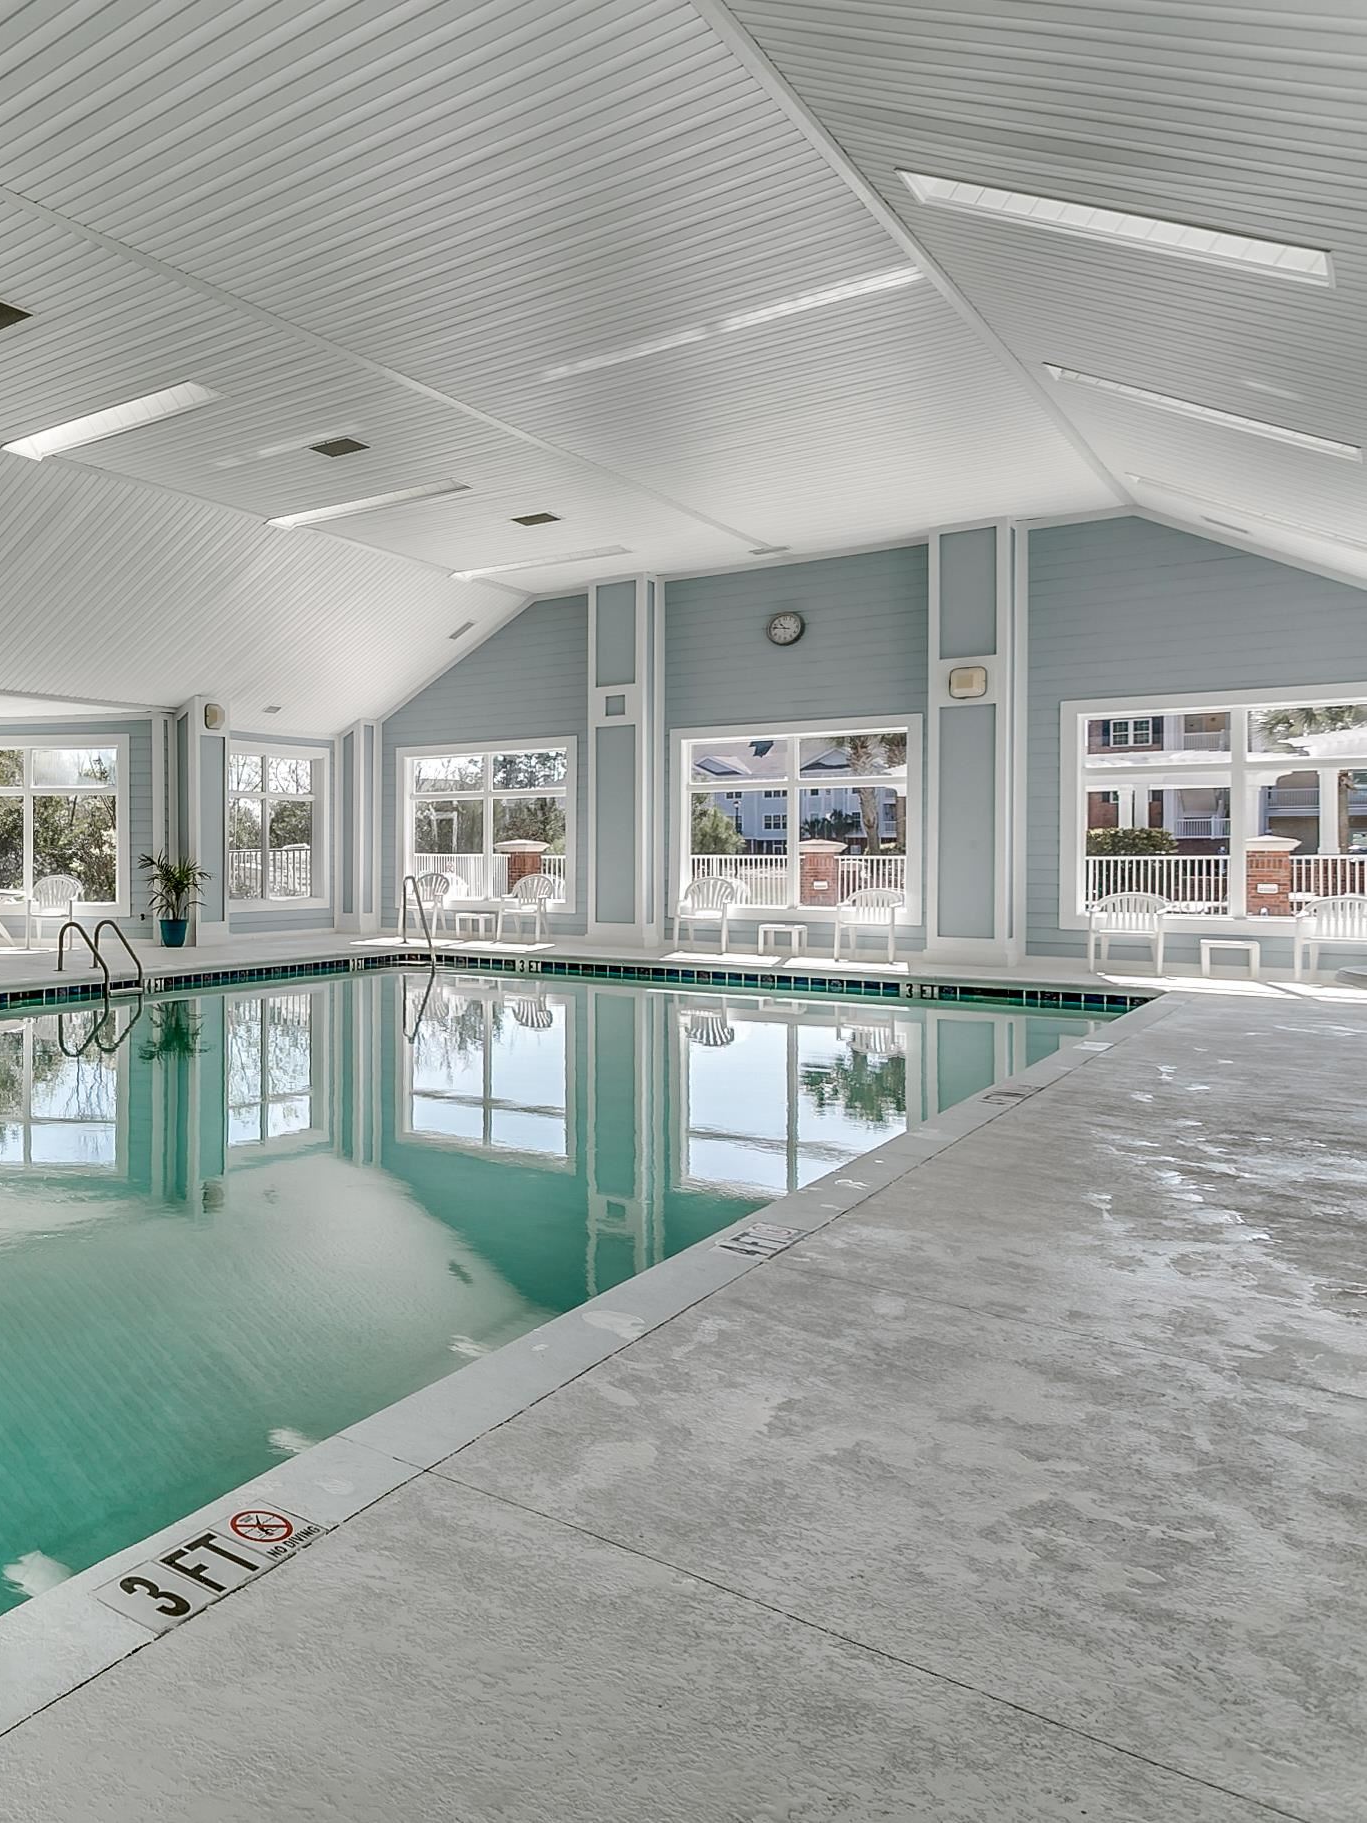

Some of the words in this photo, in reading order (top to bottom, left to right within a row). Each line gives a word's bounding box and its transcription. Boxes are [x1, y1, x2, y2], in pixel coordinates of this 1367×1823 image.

[266, 1546, 288, 1558] NO
[283, 1525, 321, 1548] DIVING
[120, 1576, 191, 1616] 3
[160, 1533, 259, 1592] FT
